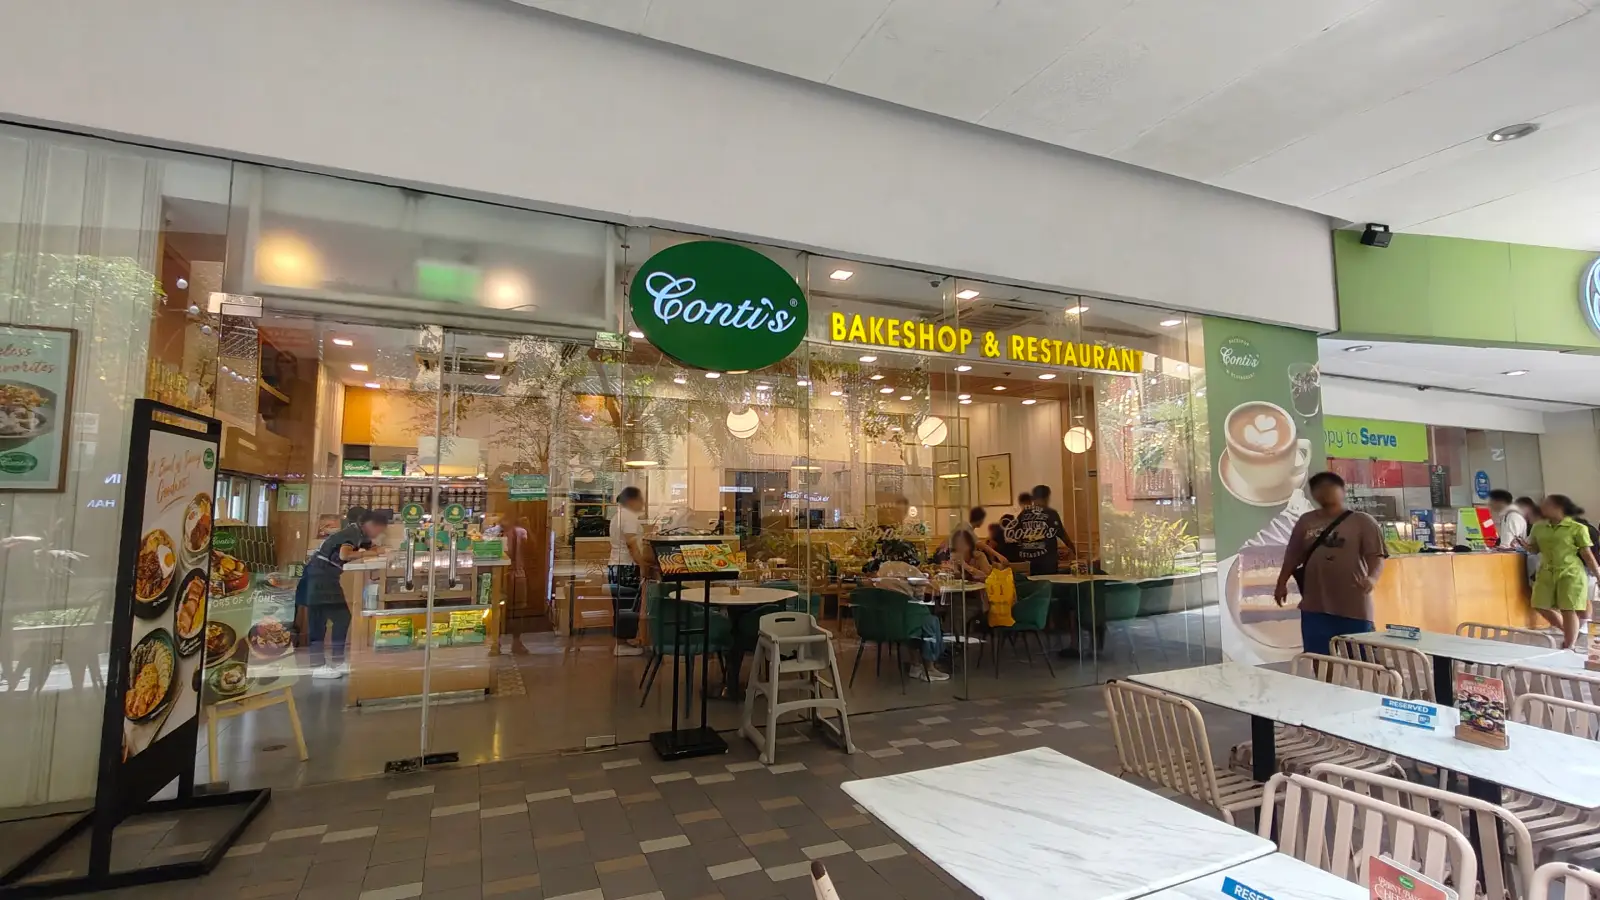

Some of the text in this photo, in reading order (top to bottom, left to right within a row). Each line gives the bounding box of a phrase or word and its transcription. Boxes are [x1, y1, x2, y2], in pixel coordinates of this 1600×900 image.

[645, 271, 797, 333] Conti's
[830, 311, 1142, 373] BAKESHOP & RESTAURANT
[1220, 346, 1260, 368] Conti's
[1346, 429, 1358, 444] to
[1360, 427, 1397, 447] Serve
[212, 600, 230, 608] ORS
[1389, 700, 1429, 713] RESERVED
[1234, 885, 1268, 900] RESE
